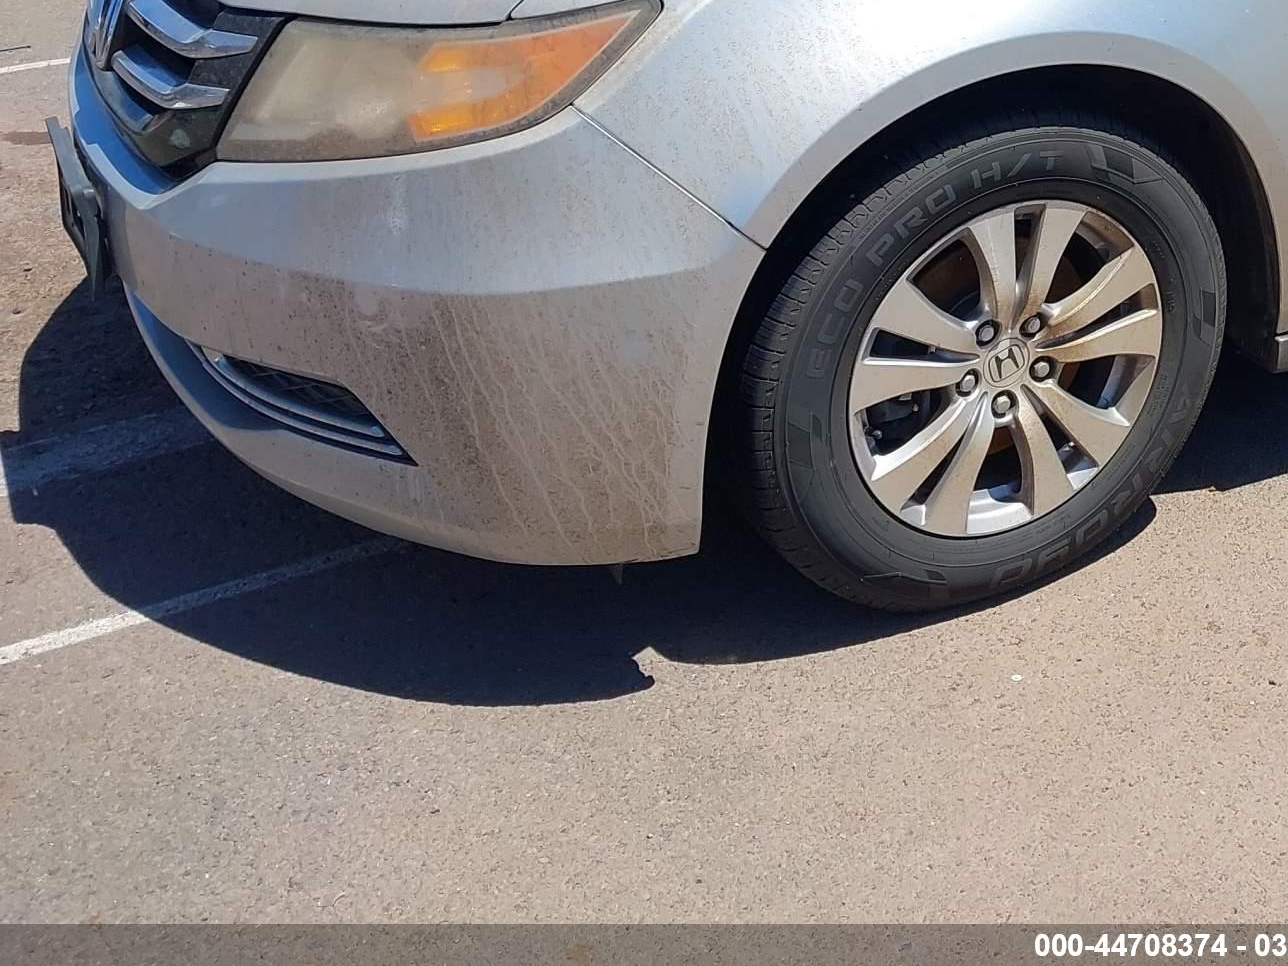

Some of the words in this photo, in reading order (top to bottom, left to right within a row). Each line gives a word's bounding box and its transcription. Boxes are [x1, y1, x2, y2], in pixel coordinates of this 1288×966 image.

[806, 280, 864, 380] ECO
[865, 186, 957, 267] PRO
[970, 149, 1065, 189] H/T
